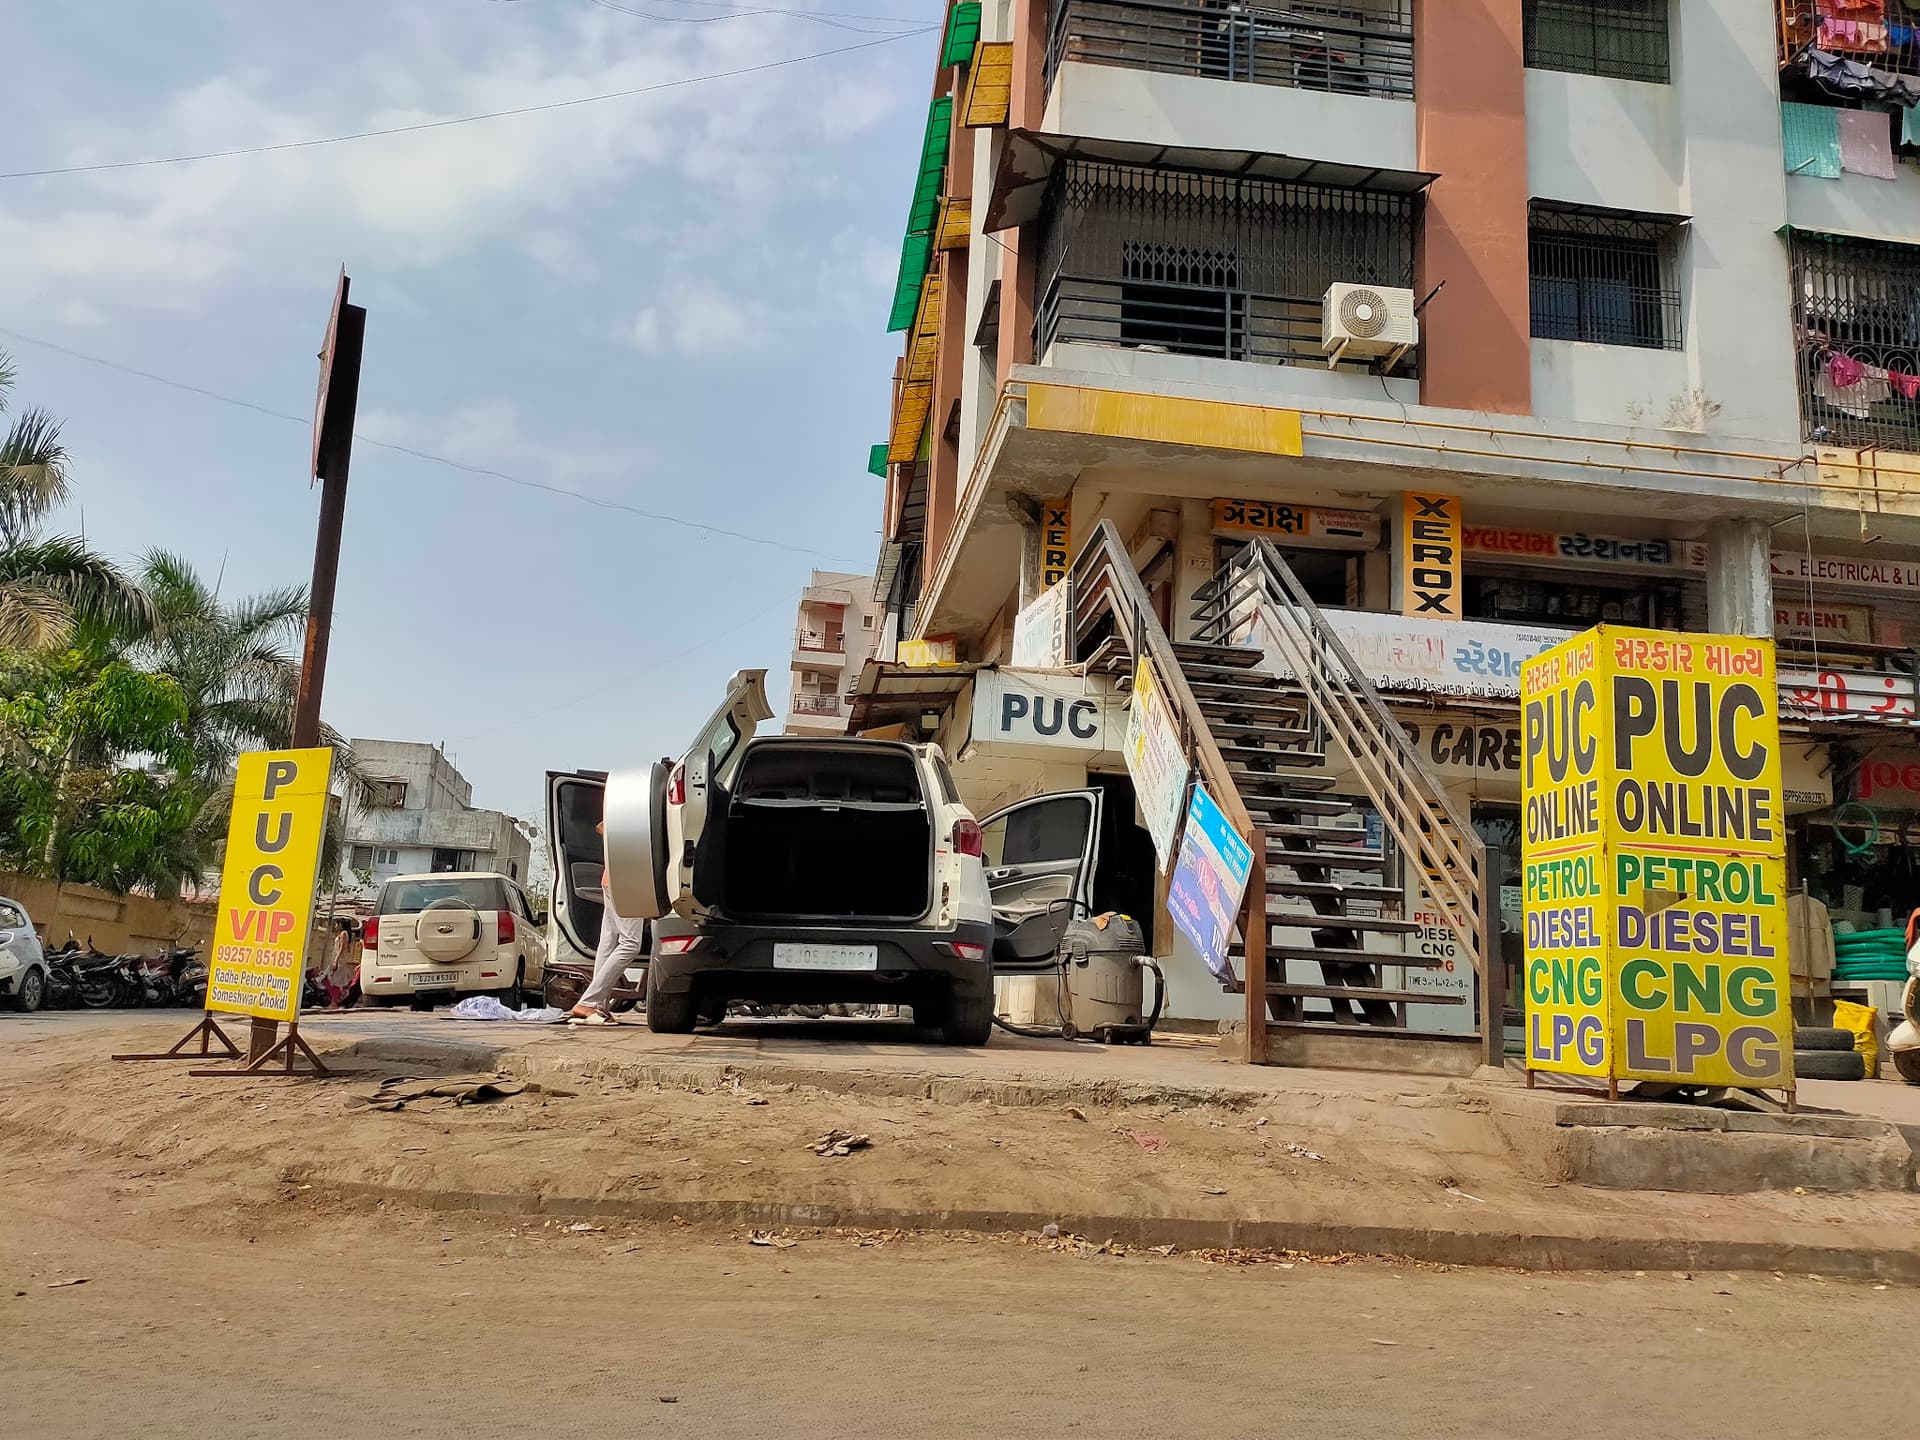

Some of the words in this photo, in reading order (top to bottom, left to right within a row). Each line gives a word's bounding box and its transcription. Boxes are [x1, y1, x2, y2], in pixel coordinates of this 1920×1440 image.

[1044, 510, 1067, 586] XERO
[1412, 496, 1454, 614] XEROX
[1800, 558, 1889, 584] ELECTRICAL
[1893, 567, 1903, 585] &
[1051, 585, 1064, 667] XEROX
[1526, 656, 1560, 696] સરકાર
[1566, 641, 1594, 680] માન્ય
[1615, 638, 1693, 673] સરકાર
[1706, 645, 1763, 678] માન્ય
[1001, 693, 1098, 738] PUC
[1526, 680, 1597, 788] PUC
[1613, 676, 1768, 781] PUC
[1431, 723, 1521, 772] CARE
[249, 760, 298, 906] PUC
[1527, 780, 1599, 845] ONLINE
[1616, 779, 1773, 842] ONLINE
[1527, 855, 1600, 902] PETROL
[1617, 854, 1776, 906] PETROL
[230, 909, 295, 944] VIP
[1415, 928, 1457, 942] DIESE
[1421, 943, 1455, 957] CNG
[1528, 907, 1601, 949] DIESEL
[1618, 906, 1775, 957] DIESEL
[215, 968, 239, 986] Radhe
[240, 971, 265, 989] Petrol
[267, 974, 290, 993] Pump
[217, 945, 251, 964] 99257
[255, 949, 293, 968] 85185
[1530, 957, 1602, 1006] CNG
[211, 985, 257, 1005] Someshwar
[258, 991, 288, 1011] Chokdi
[1620, 959, 1777, 1017] CNG
[1532, 1014, 1604, 1068] LPG
[1626, 1019, 1782, 1079] LPG
